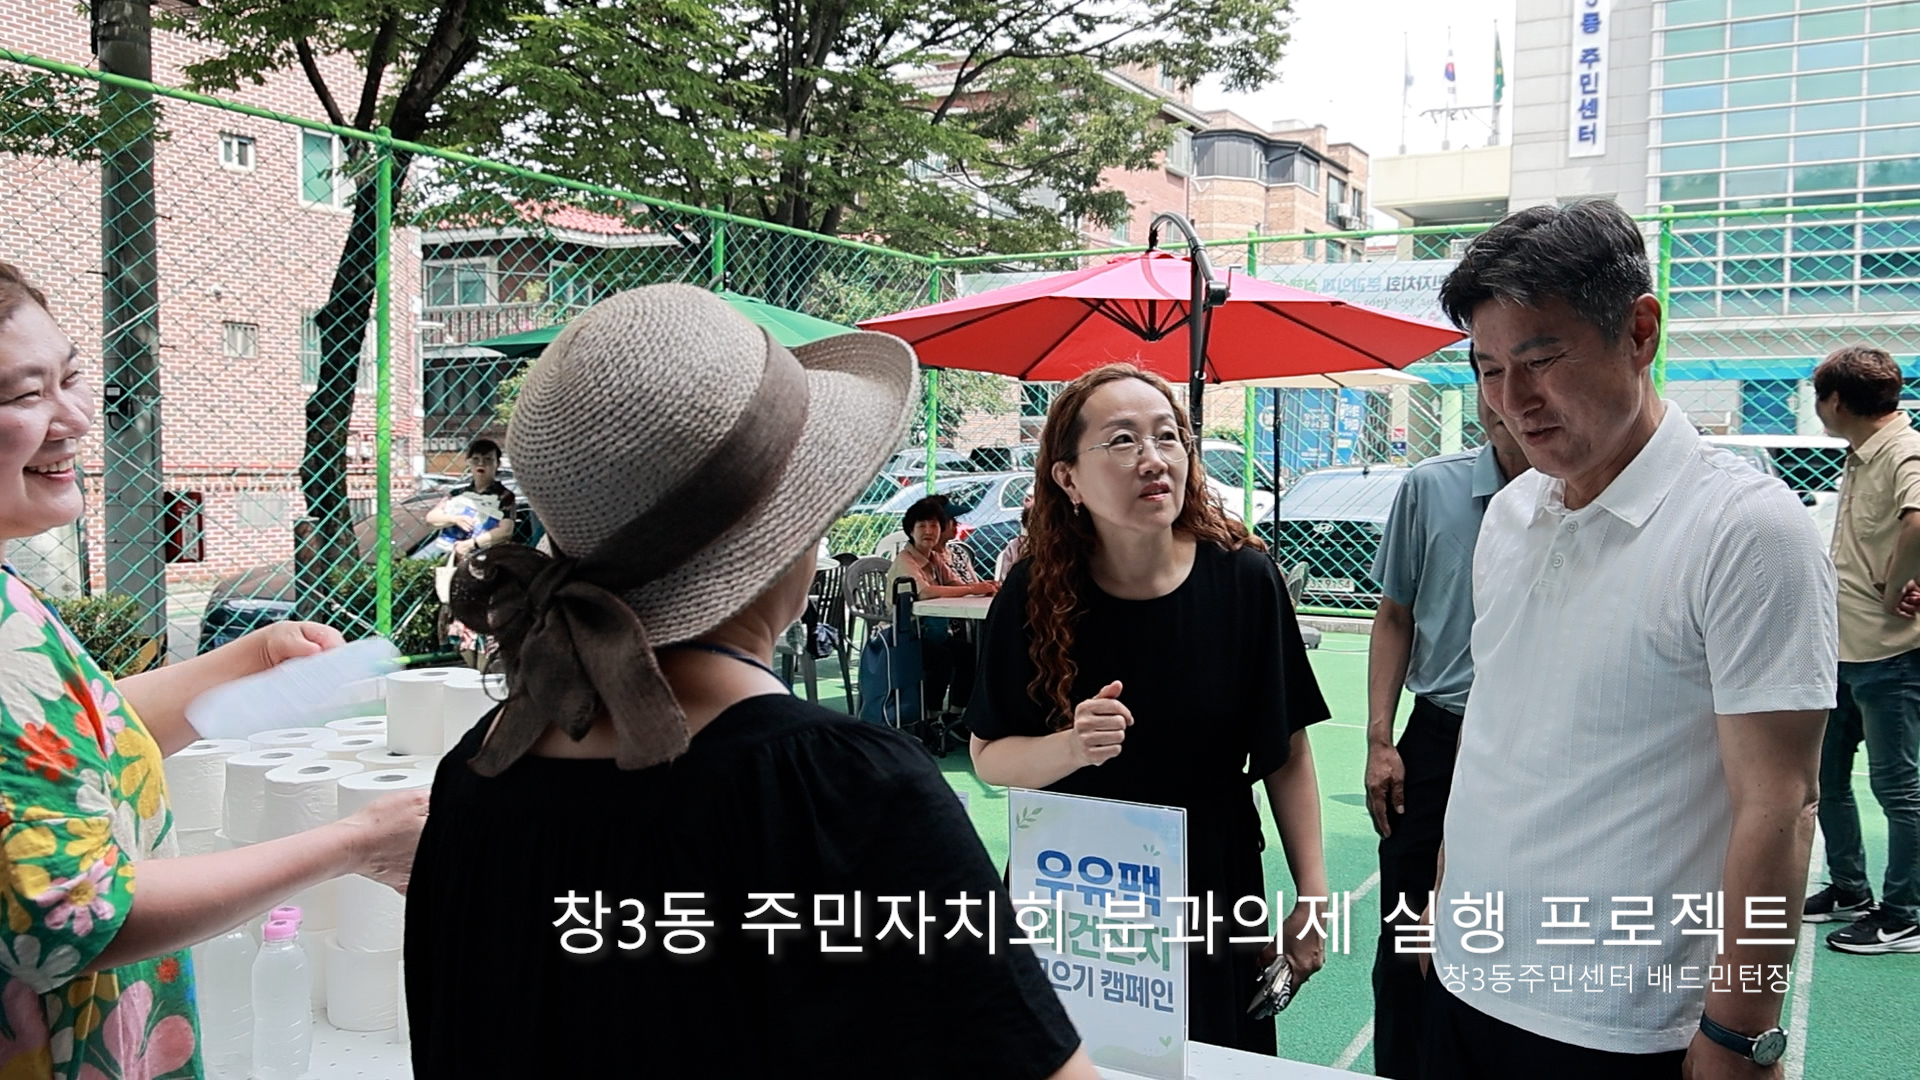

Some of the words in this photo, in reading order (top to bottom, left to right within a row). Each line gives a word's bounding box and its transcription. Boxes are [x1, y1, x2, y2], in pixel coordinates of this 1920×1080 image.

[1577, 47, 1601, 145] 주민센터
[1035, 850, 1161, 917] 우유팩
[1101, 969, 1174, 1013] 캠페인
